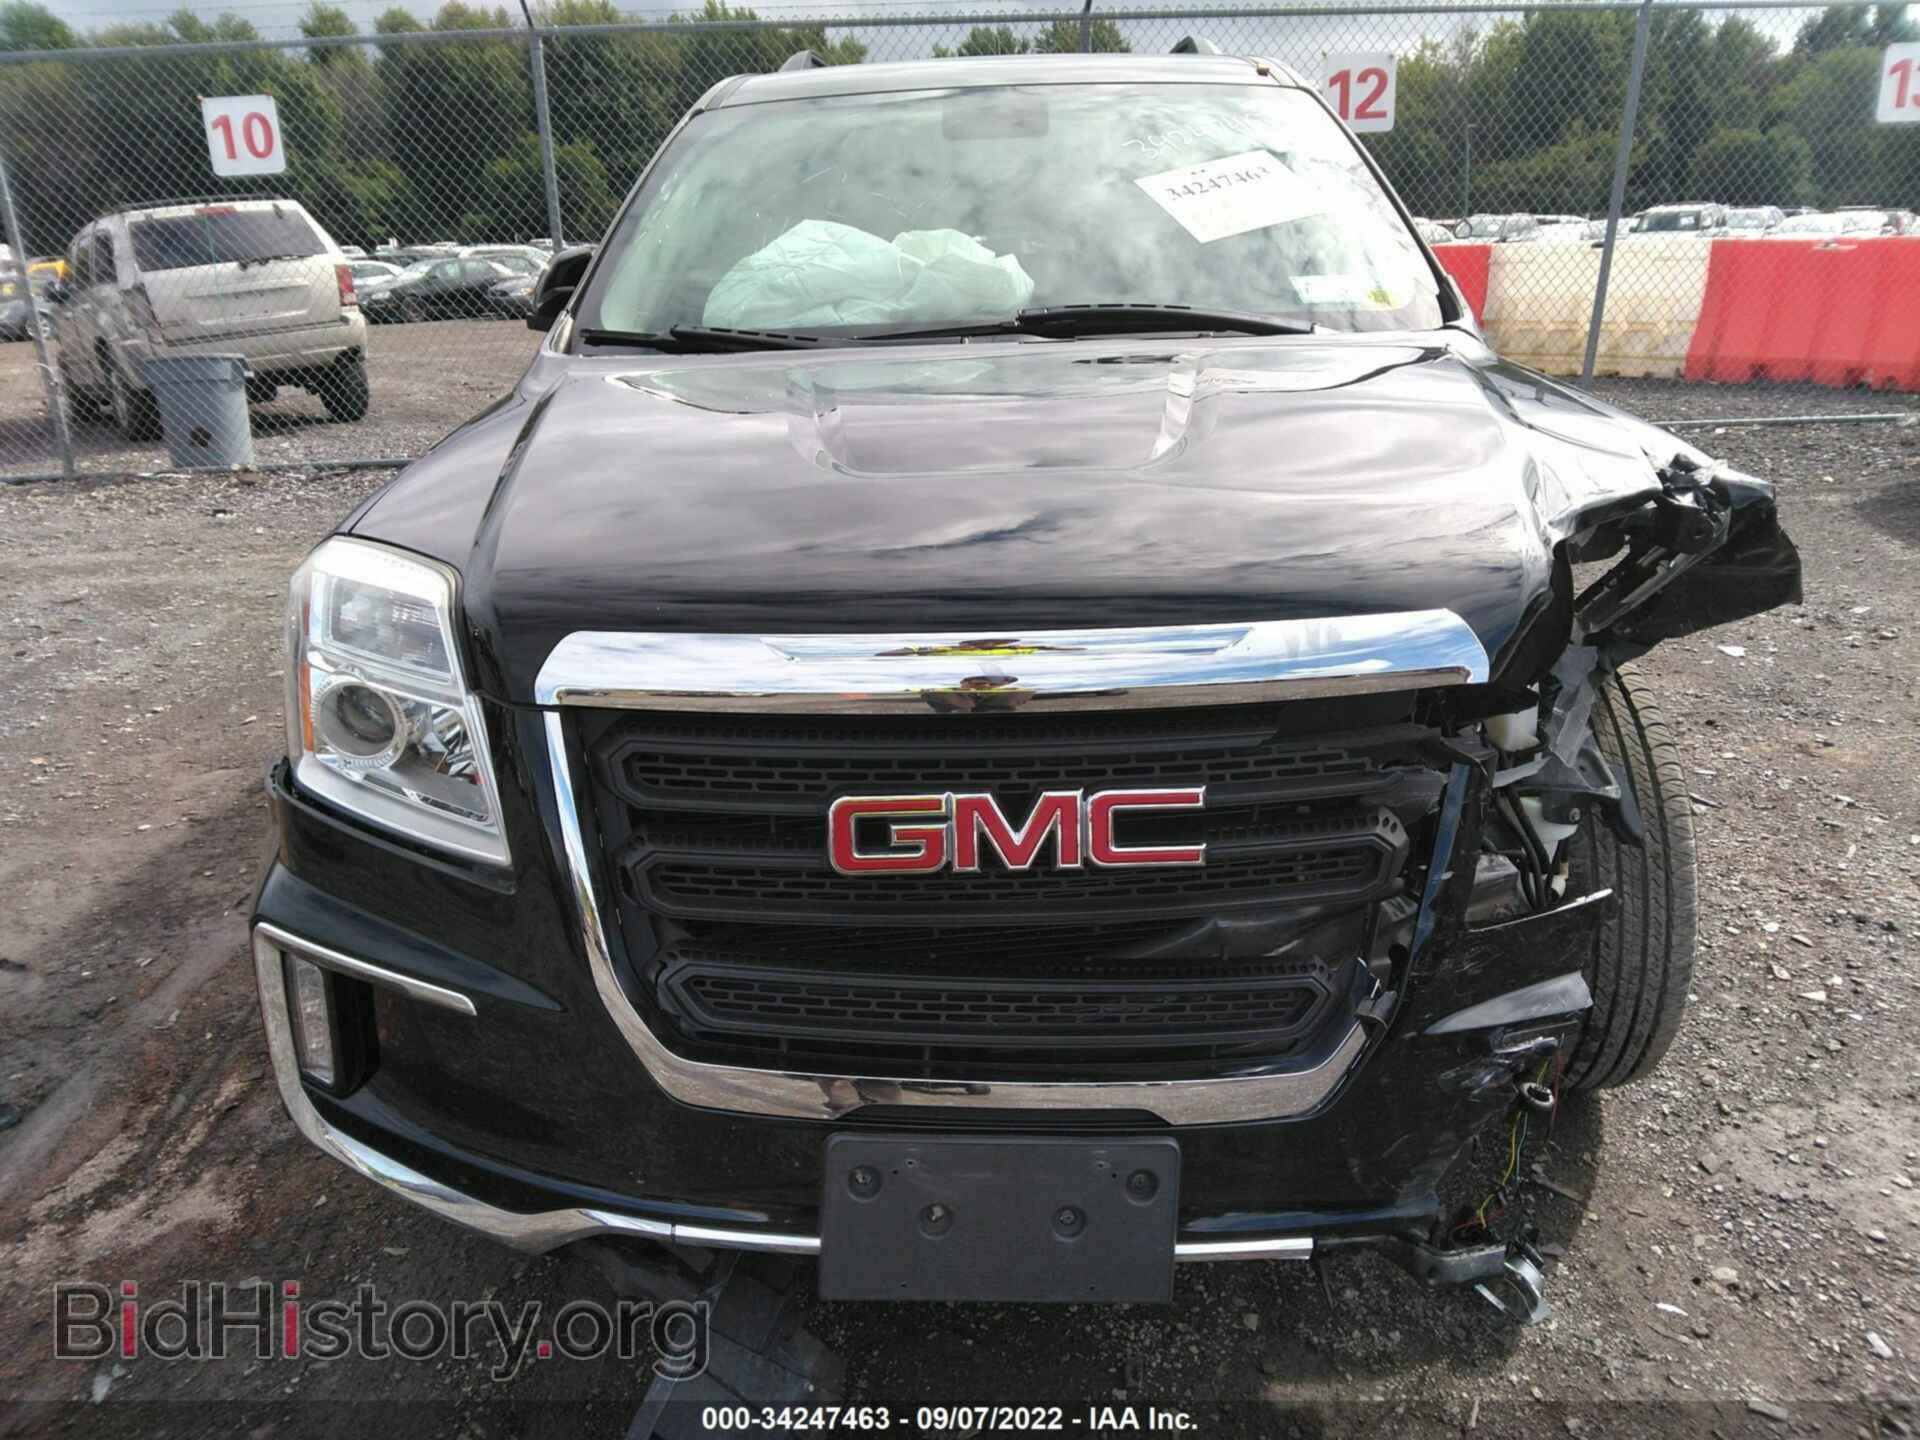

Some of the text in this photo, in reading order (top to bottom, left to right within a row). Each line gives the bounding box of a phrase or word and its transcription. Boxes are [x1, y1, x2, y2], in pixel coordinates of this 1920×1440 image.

[1328, 67, 1389, 122] 12
[210, 111, 276, 160] 10
[828, 785, 1207, 875] GMC
